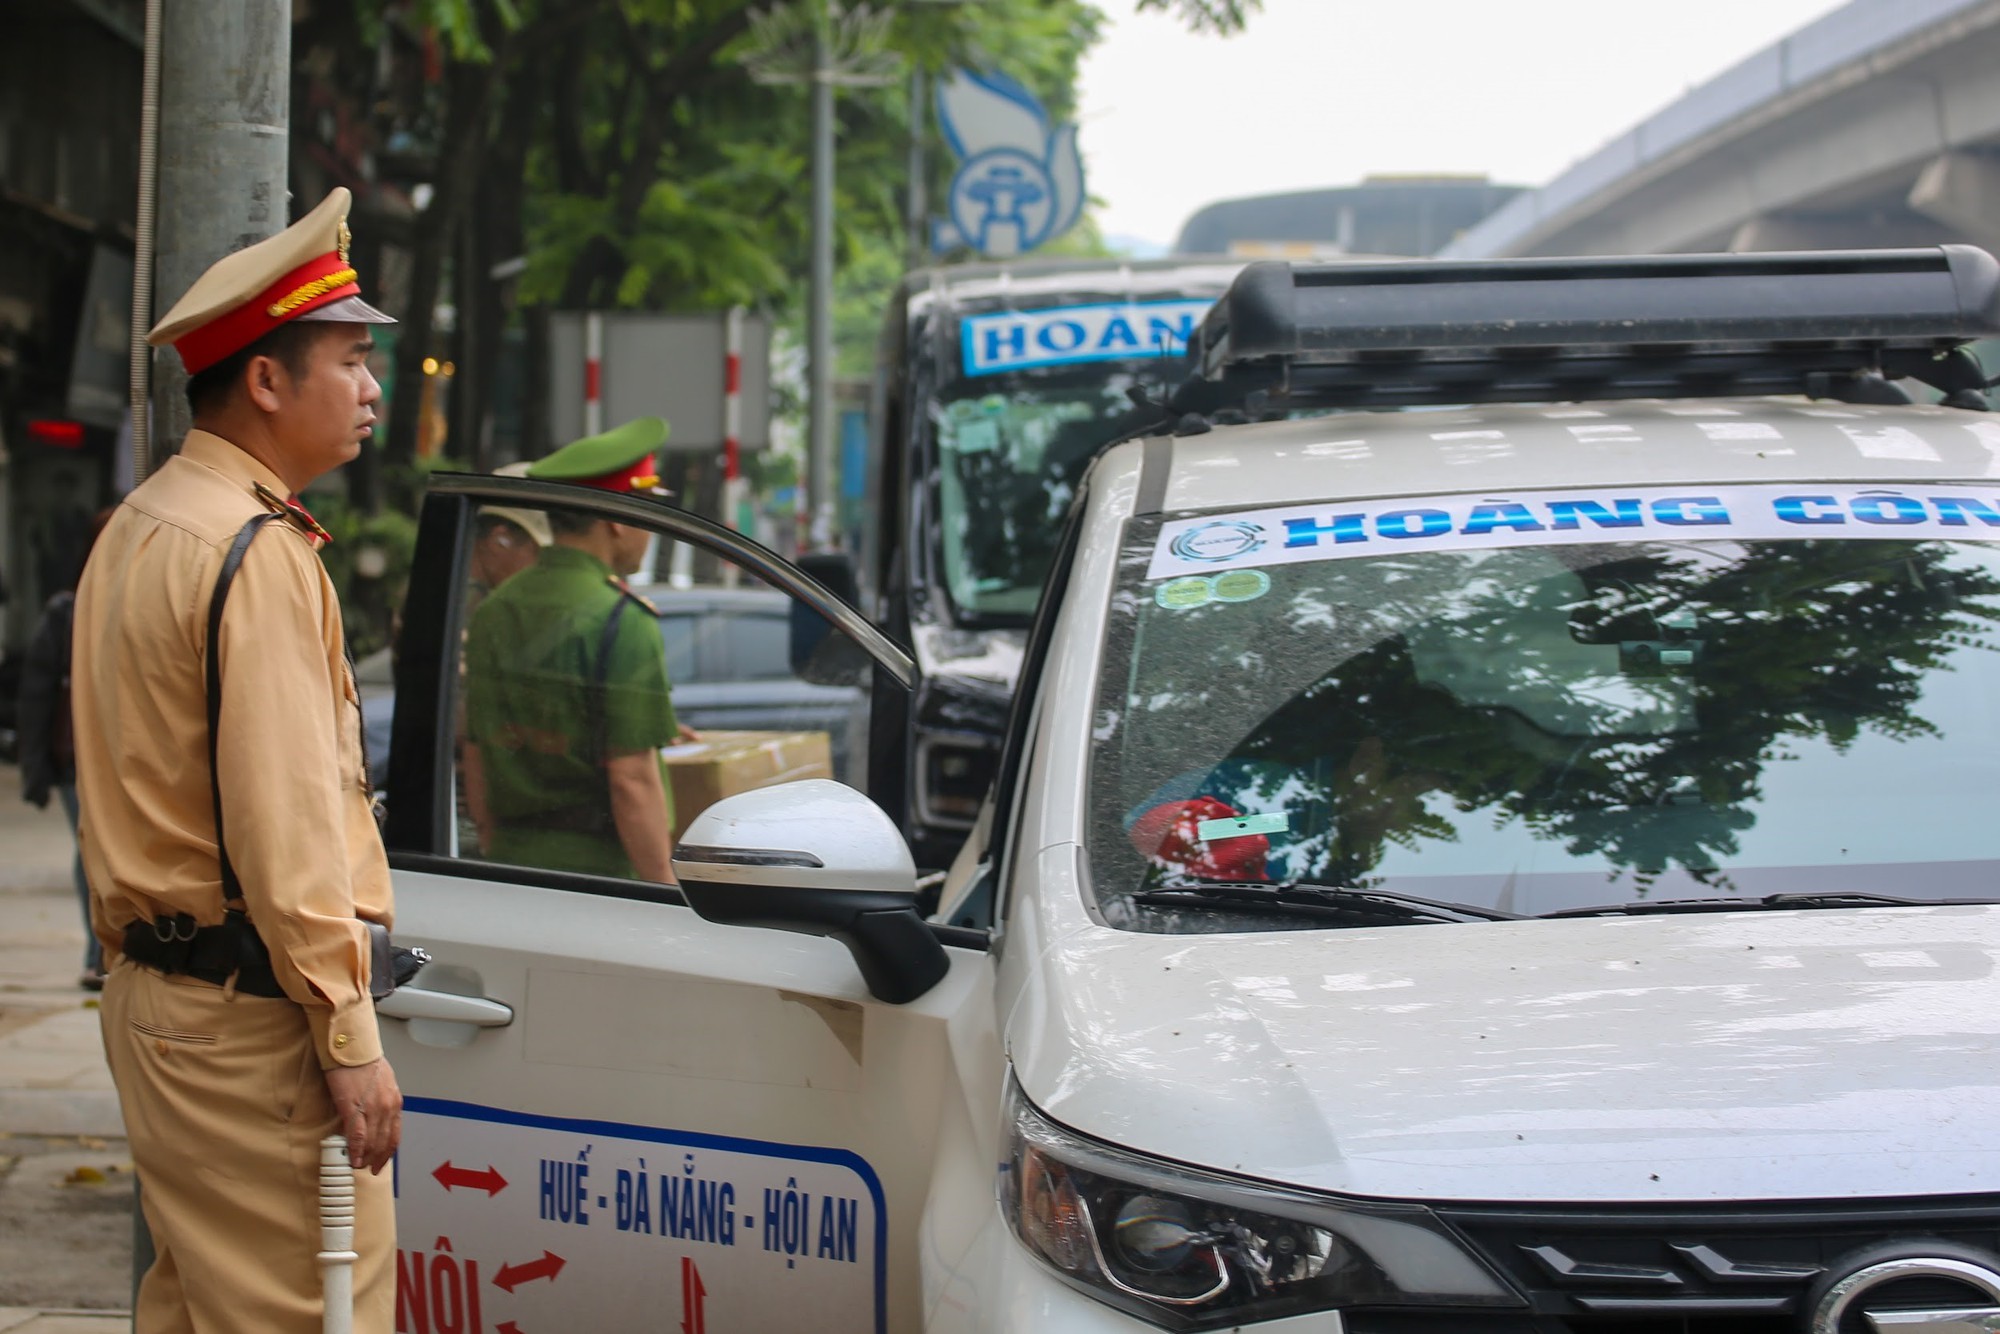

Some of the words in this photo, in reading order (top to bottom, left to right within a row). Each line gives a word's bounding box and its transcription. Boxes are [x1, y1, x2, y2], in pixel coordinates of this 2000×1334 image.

[1282, 496, 1732, 548] HOÀNG
[1772, 489, 2000, 527] CÔN
[540, 1144, 592, 1226] HUẾ
[616, 1157, 652, 1235] ĐÀ
[764, 1177, 809, 1269] HỘI
[818, 1195, 857, 1263] AN
